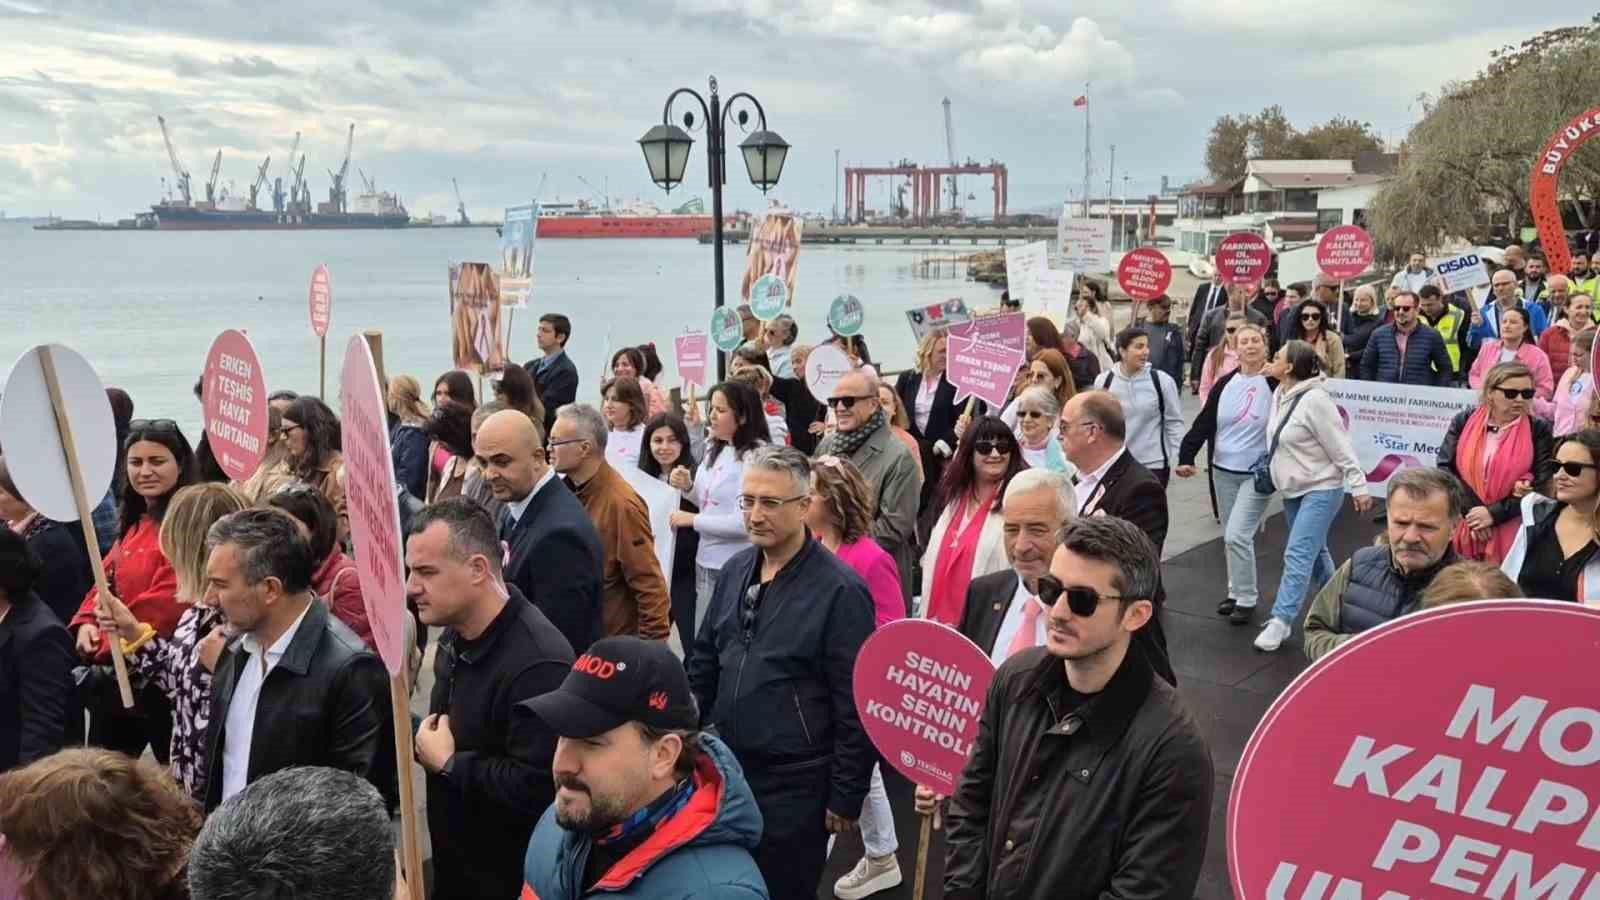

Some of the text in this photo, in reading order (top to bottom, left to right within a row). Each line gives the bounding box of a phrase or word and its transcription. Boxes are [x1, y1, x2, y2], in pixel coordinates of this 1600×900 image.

[1437, 254, 1479, 273] CISAD
[219, 353, 252, 380] ERKEN
[218, 375, 254, 403] TEŞHİS
[1345, 392, 1370, 401] MEME
[1372, 394, 1407, 406] KANSERİ
[1408, 397, 1463, 410] FARKINDALIK
[219, 399, 250, 426] HAYAT
[210, 418, 259, 453] KURTARIR
[1385, 439, 1409, 451] Star
[904, 651, 972, 691] SENİN
[901, 694, 968, 734] SENİN
[1371, 819, 1600, 900] PEM
